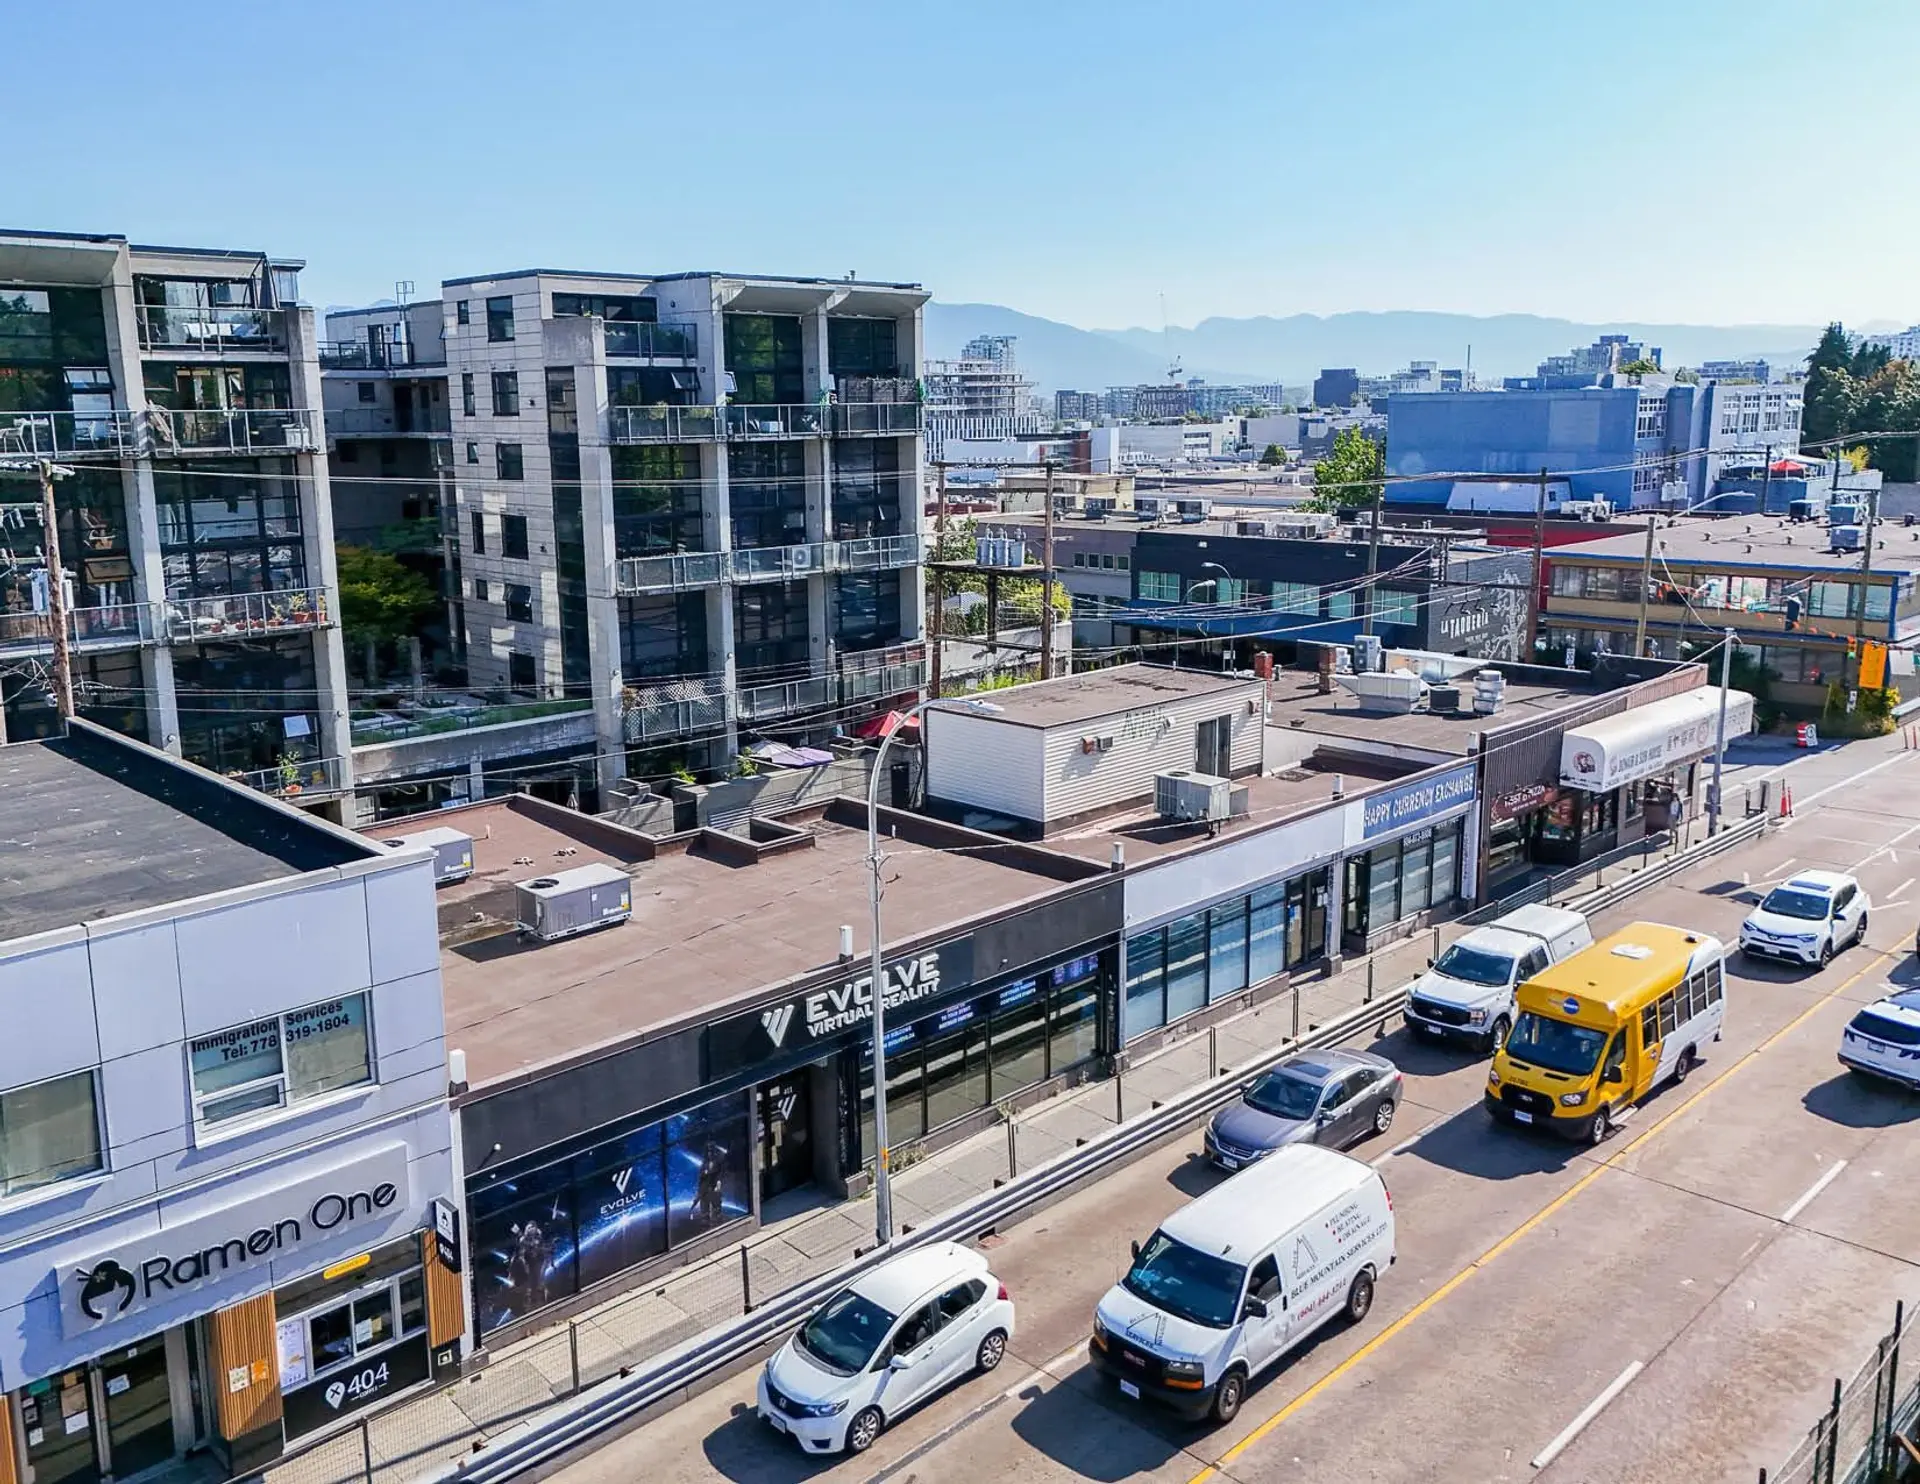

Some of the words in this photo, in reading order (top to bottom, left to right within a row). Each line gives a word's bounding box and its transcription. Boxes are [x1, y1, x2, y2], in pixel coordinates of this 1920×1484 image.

[1440, 620, 1449, 635] LA
[1450, 611, 1489, 639] TAQUERIA
[1363, 800, 1391, 828] HAPPY
[1392, 786, 1434, 818] CURRENCY
[1435, 772, 1474, 802] EXCHANGE
[806, 952, 940, 1023] EVOLVE
[807, 1006, 874, 1037] VIRTUAL
[882, 978, 941, 1010] REALITY
[192, 1021, 277, 1053] Immigration
[286, 1001, 343, 1025] Services
[222, 1044, 248, 1061] Tel:
[250, 1035, 277, 1053] 778
[286, 1014, 350, 1042] 319-1804
[600, 1189, 646, 1214] EVOLVE
[142, 1218, 300, 1298] Ramen
[310, 1182, 397, 1230] One
[1291, 1282, 1309, 1299] BLUE
[1310, 1255, 1346, 1283] MOUNTAIN
[348, 1362, 389, 1395] 404
